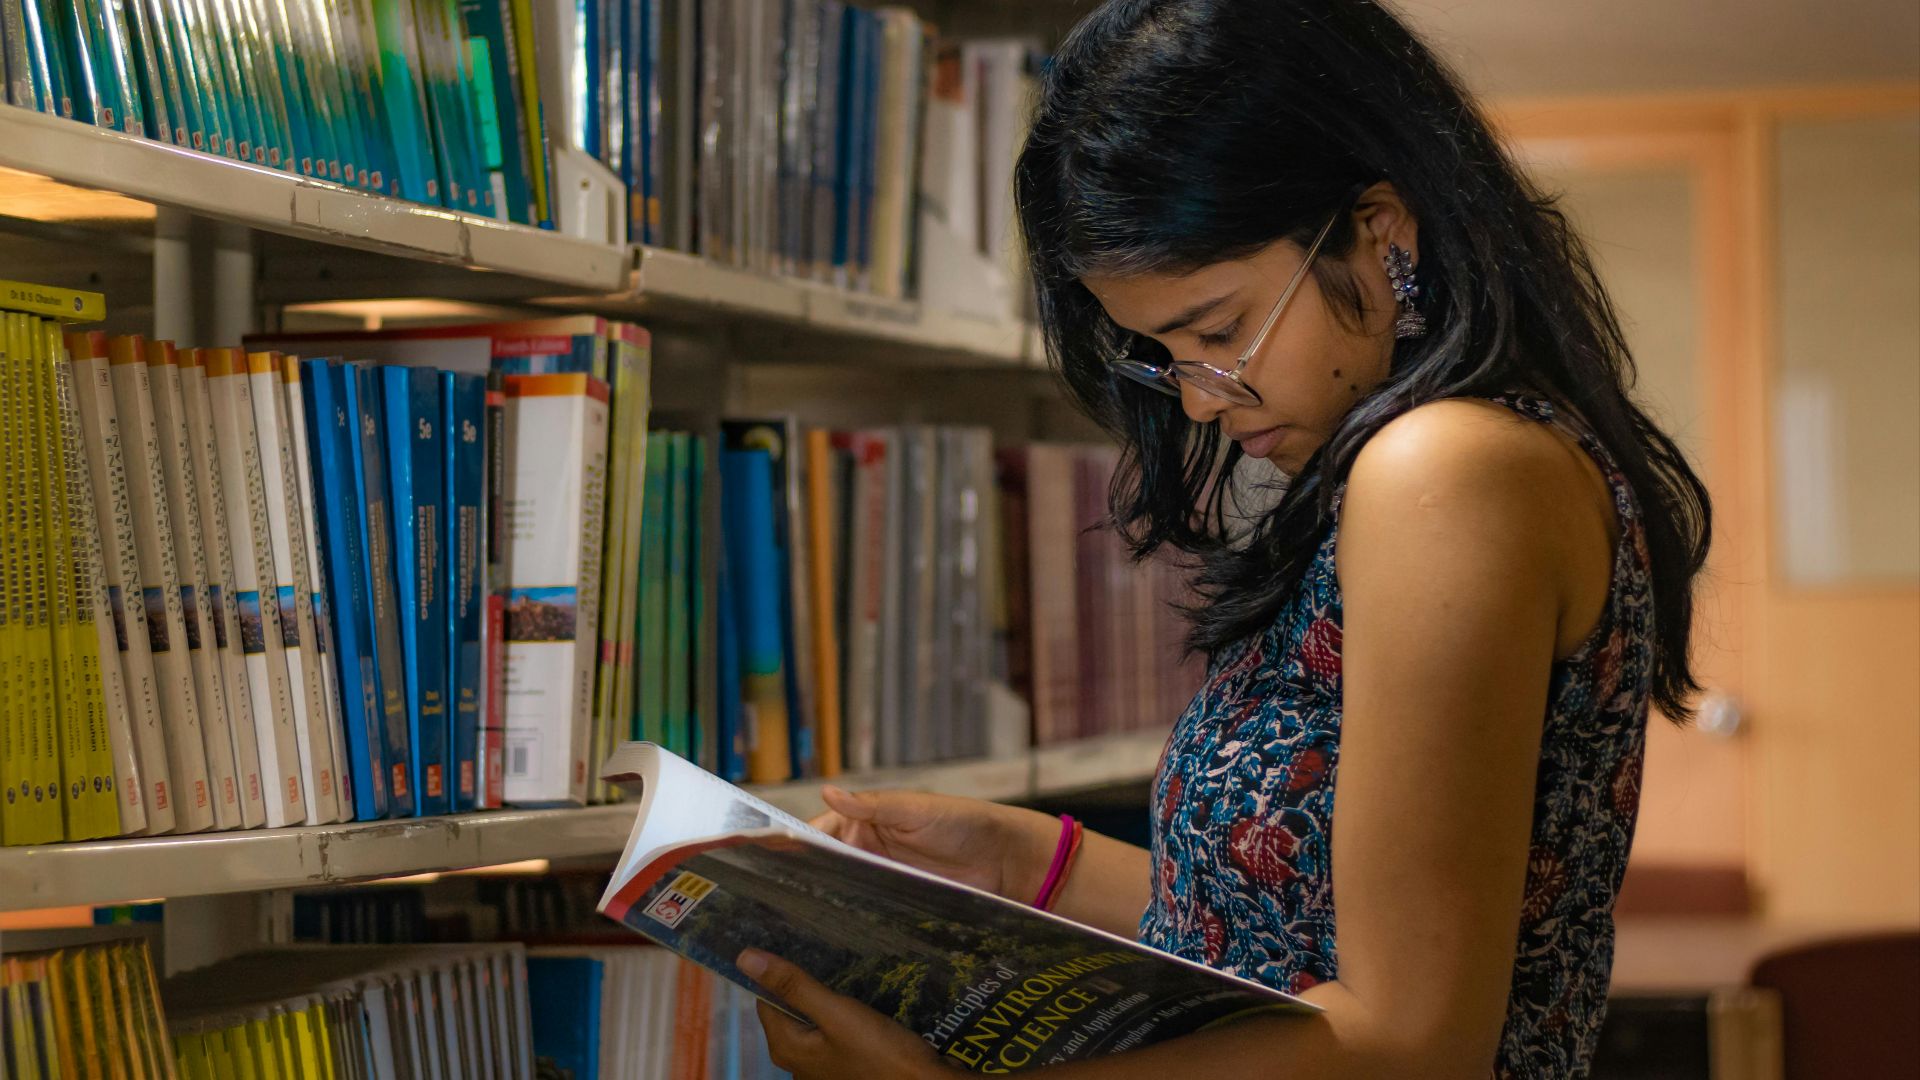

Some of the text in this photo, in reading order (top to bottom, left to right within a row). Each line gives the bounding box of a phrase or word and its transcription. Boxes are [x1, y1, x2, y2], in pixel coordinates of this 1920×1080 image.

[419, 417, 432, 440] 5e
[463, 419, 477, 443] 5e
[142, 677, 155, 729] KIELY
[182, 676, 195, 728] KIELY
[922, 962, 1019, 1050] Principles of
[1063, 991, 1151, 1056] and Applications
